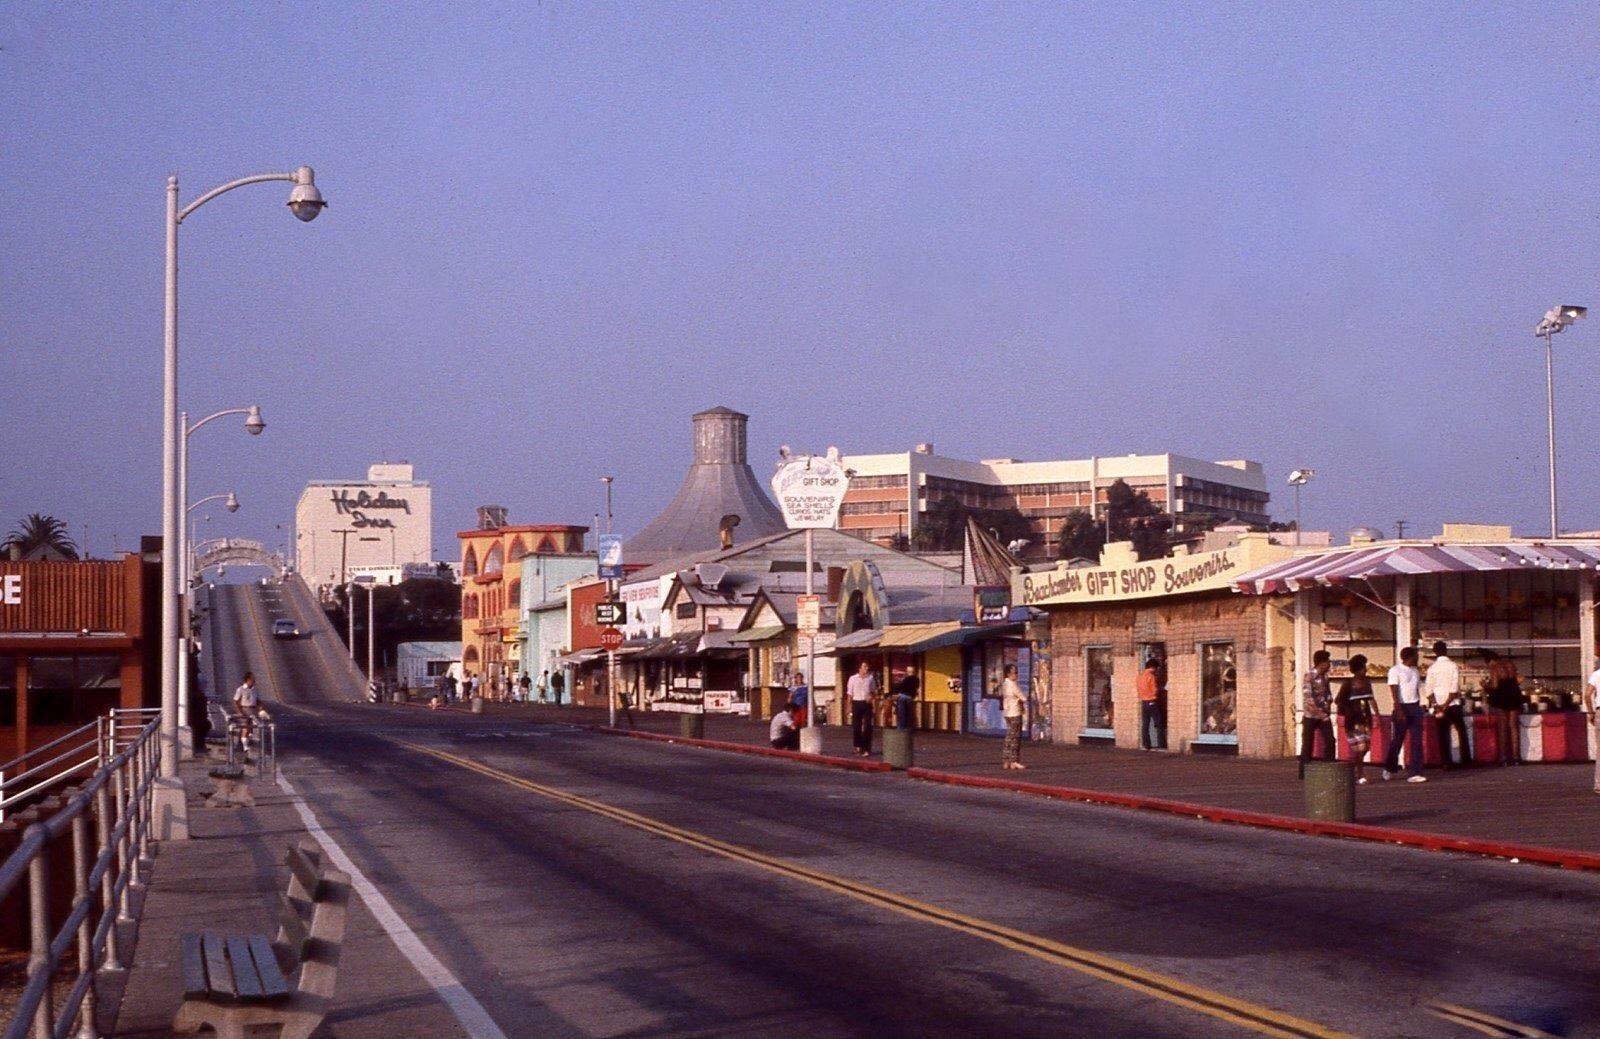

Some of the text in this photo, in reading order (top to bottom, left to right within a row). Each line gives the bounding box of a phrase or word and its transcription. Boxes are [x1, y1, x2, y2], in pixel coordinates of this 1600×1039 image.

[820, 478, 839, 486] SHOP
[330, 489, 411, 515] Holiday
[351, 511, 396, 528] Inn
[0, 575, 21, 604] E
[1086, 571, 1117, 596] GIFT
[1120, 566, 1156, 594] SHOP
[601, 634, 622, 643] STOP
